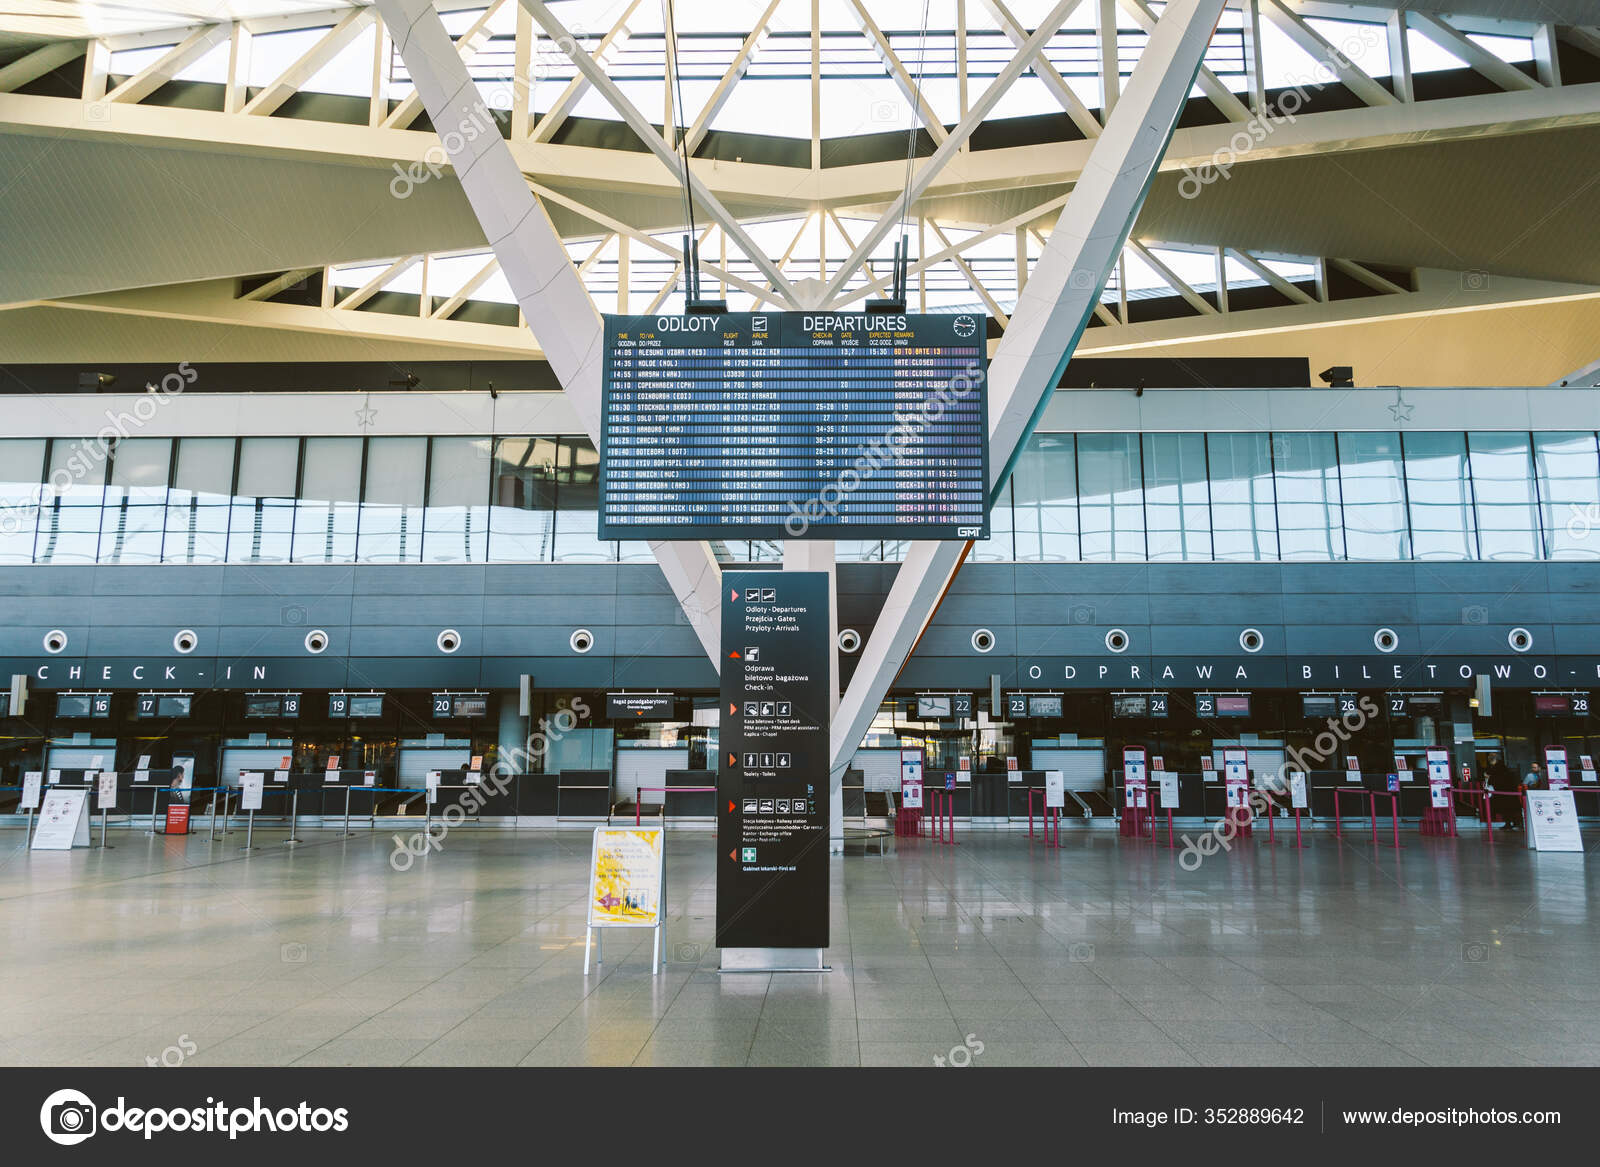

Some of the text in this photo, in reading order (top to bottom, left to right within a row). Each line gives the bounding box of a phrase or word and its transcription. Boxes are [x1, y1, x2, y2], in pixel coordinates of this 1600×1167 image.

[656, 315, 906, 331] ODLOTY DEPARTURES
[751, 370, 762, 378] LOT
[613, 392, 631, 400] 15:15
[823, 414, 830, 422] 27
[844, 414, 848, 422] 7
[958, 527, 981, 536] GMT
[38, 667, 265, 679] CHECK-IN
[1030, 665, 1600, 680] ODPRAWA BILETOWO-
[96, 701, 107, 710] 16
[142, 701, 152, 710] 17
[286, 701, 296, 711] 18
[333, 701, 344, 711] 19
[436, 701, 449, 710] 20
[956, 701, 968, 711] 22
[1012, 701, 1024, 710] 23
[1152, 701, 1165, 710] 24
[1200, 701, 1211, 710] 25
[1342, 701, 1356, 712] 26
[1392, 700, 1403, 710] 27
[1574, 700, 1587, 710] 28
